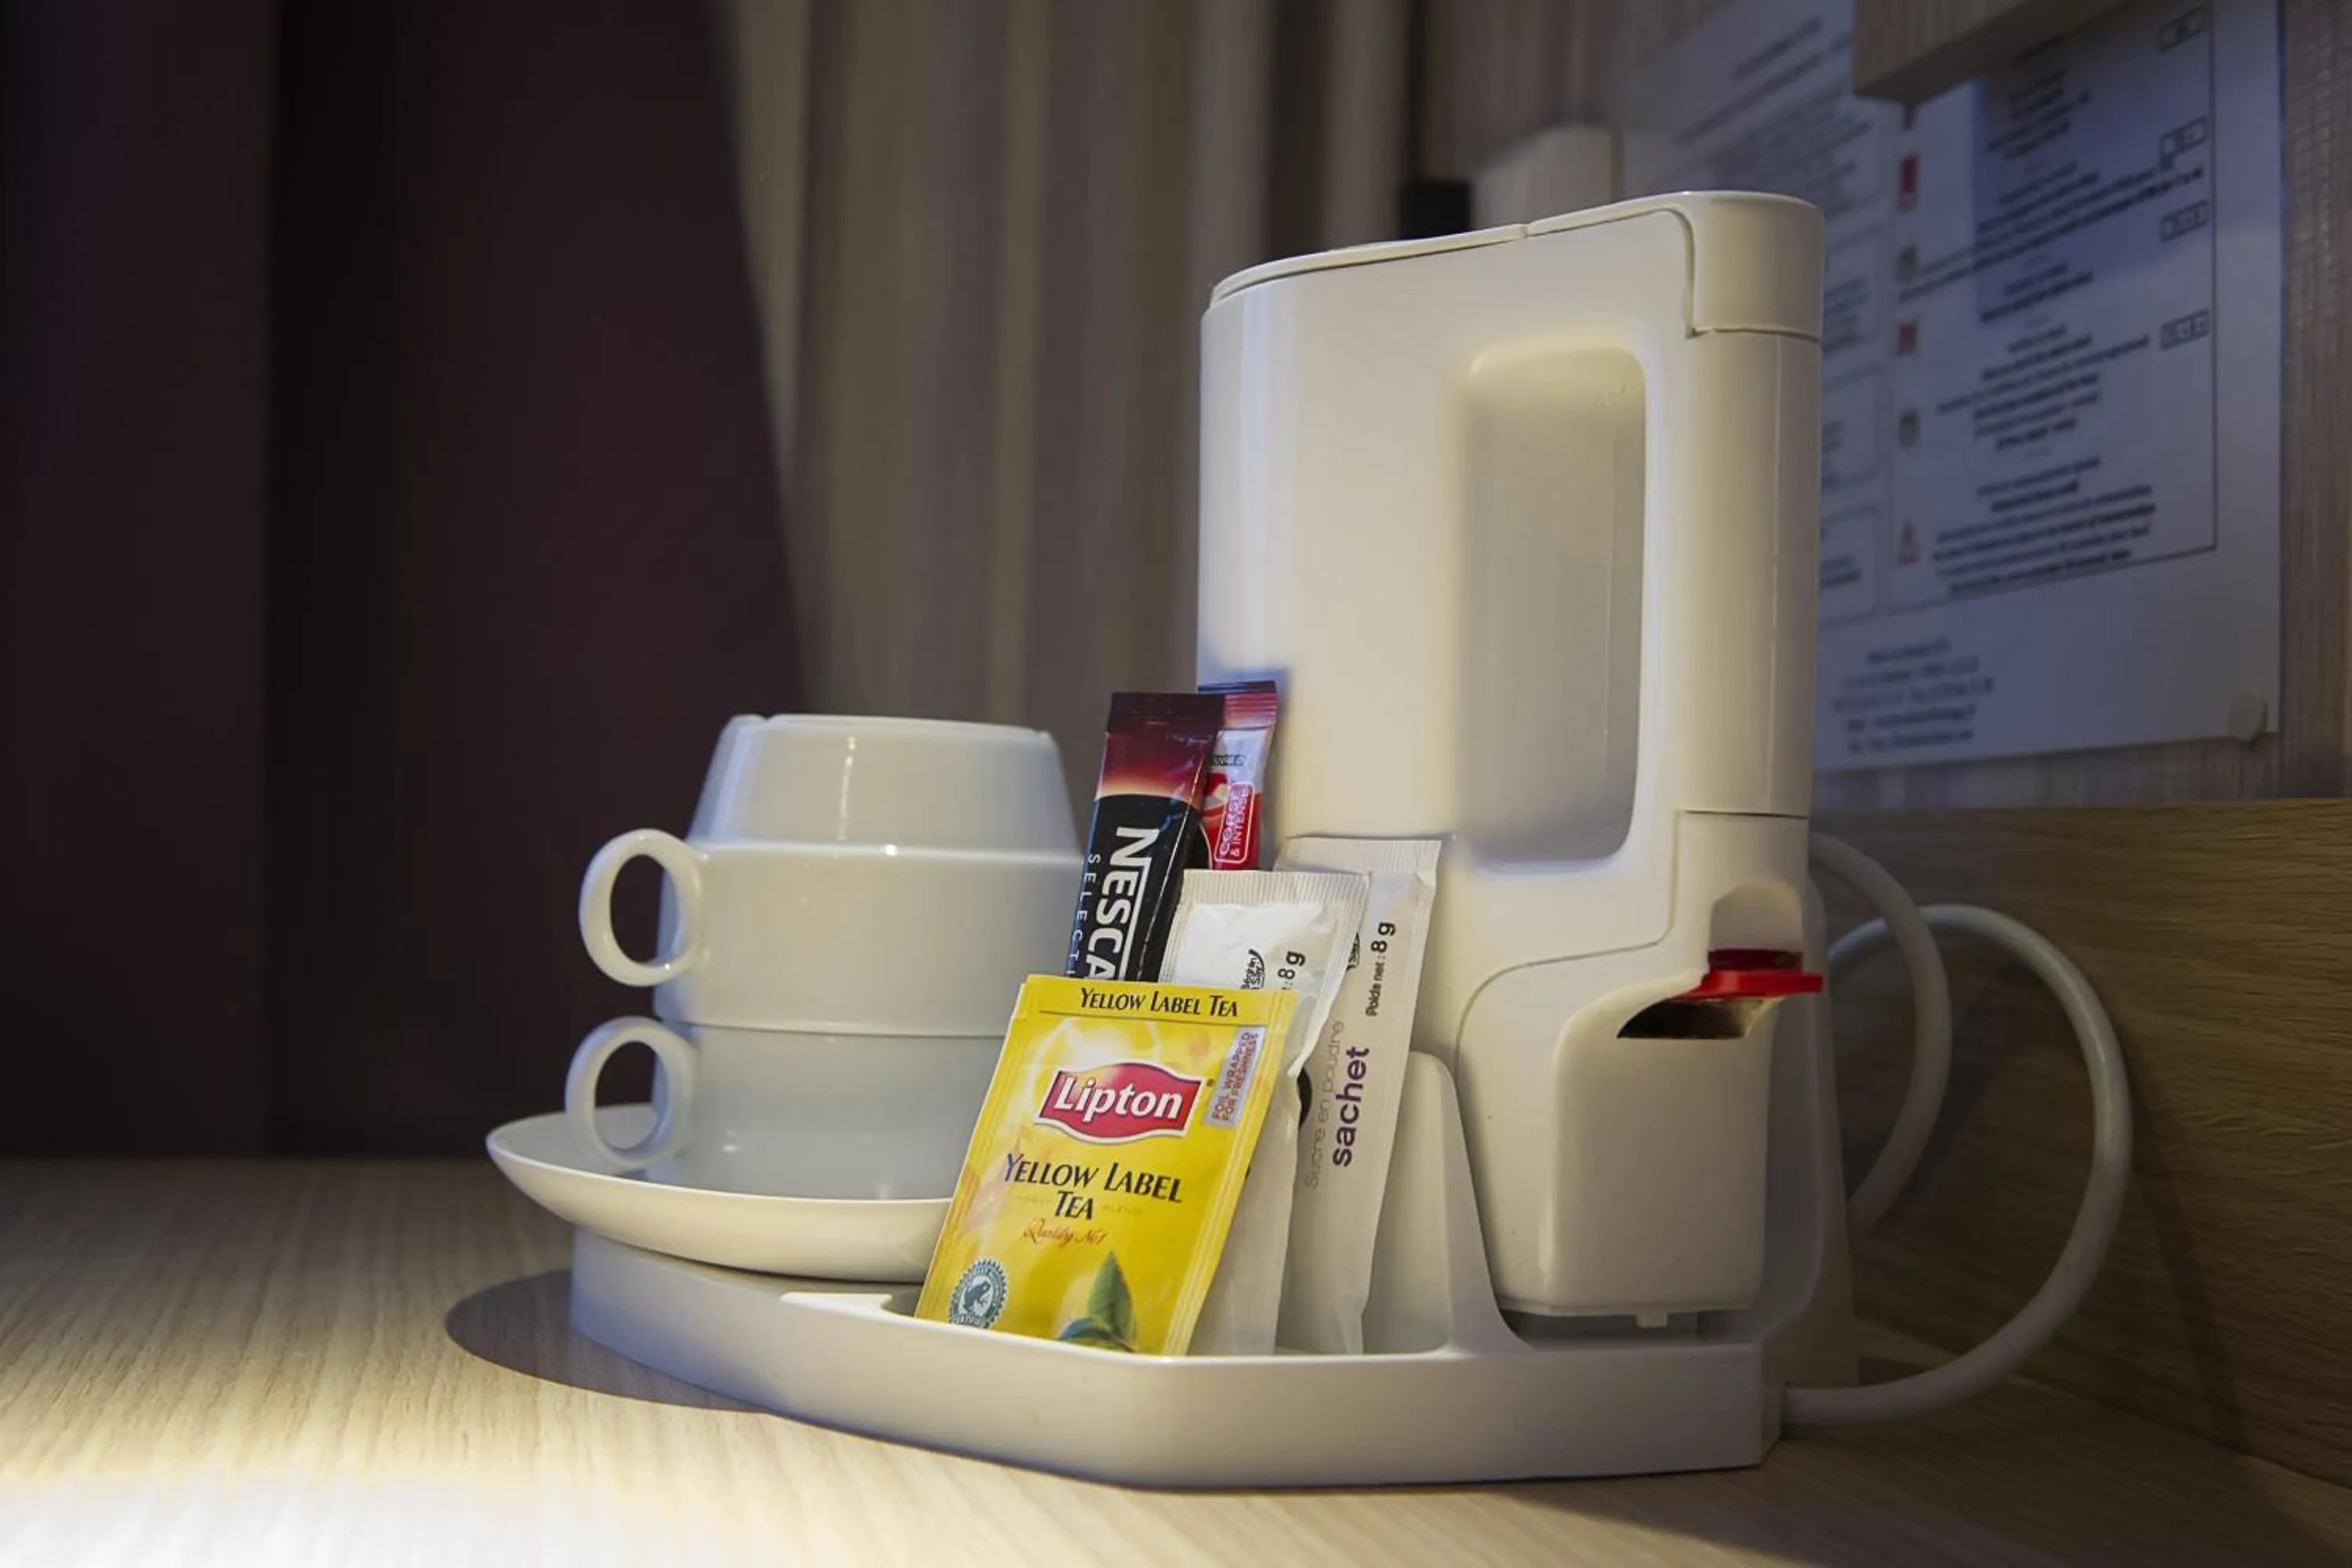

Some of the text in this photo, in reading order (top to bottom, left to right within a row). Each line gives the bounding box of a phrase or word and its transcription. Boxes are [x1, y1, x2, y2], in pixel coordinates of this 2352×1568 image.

[1377, 922, 1396, 937] g
[1285, 951, 1306, 967] g
[1370, 940, 1388, 953] 8
[1277, 968, 1296, 980] 8
[1080, 987, 1238, 1018] YELLOW LABEL TEA
[1365, 983, 1382, 1016] Poids
[1054, 1076, 1183, 1123] Lipton
[1304, 1020, 1345, 1190] Sucre en poudre
[1332, 1045, 1370, 1168] sachet
[1004, 1153, 1183, 1203] YELLOW LABEL
[1054, 1190, 1094, 1220] TEA
